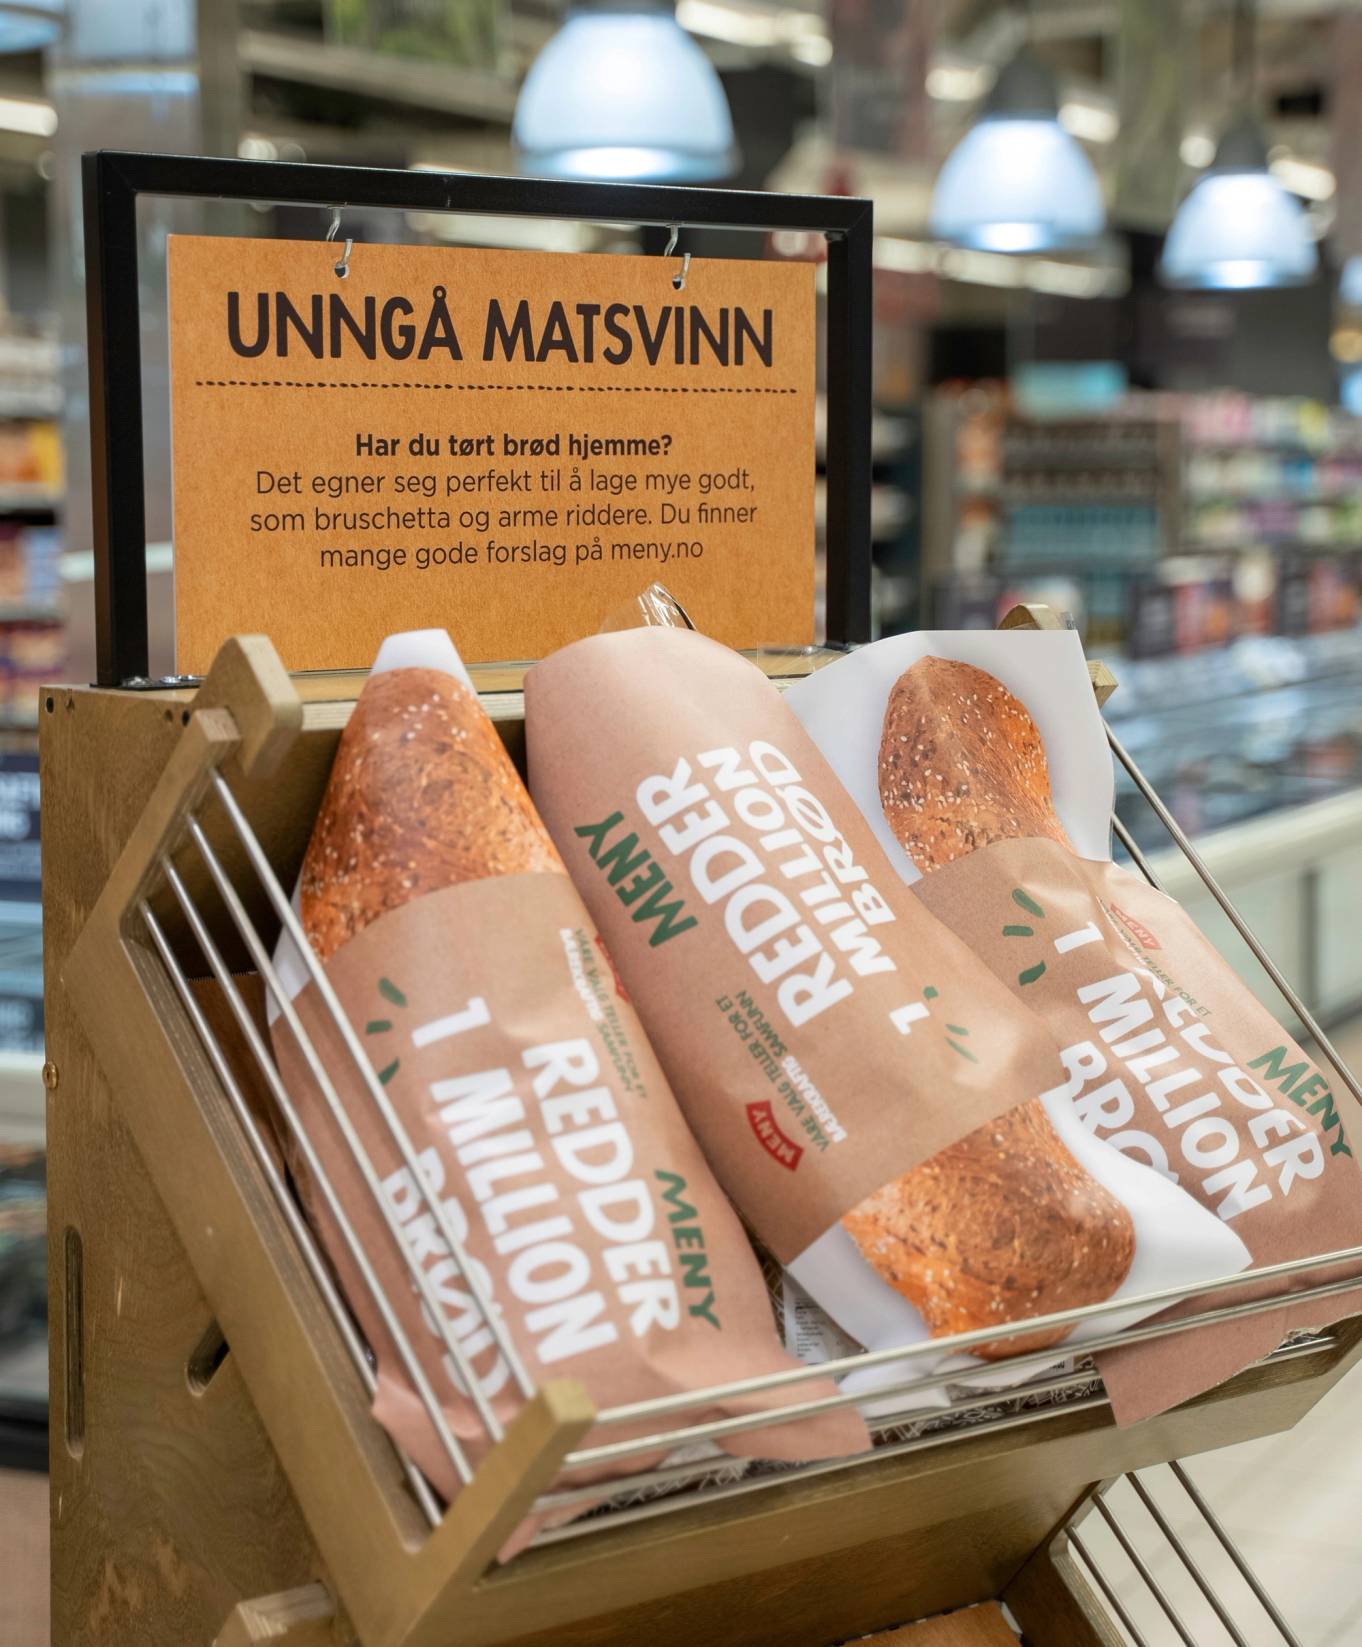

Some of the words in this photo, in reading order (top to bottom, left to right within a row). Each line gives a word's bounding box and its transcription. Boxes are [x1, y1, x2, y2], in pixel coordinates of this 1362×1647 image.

[227, 285, 463, 362] UNNGÅ
[482, 297, 774, 368] MATSVINN
[256, 470, 303, 494] Det
[311, 475, 386, 498] egner
[394, 474, 437, 497] seg
[446, 468, 532, 497] perfekt
[539, 468, 561, 491] til
[568, 466, 582, 491] å
[590, 468, 638, 496] lage
[645, 472, 691, 494] mye
[698, 467, 755, 494] godt,
[355, 433, 401, 457] Har
[408, 432, 440, 457] du
[448, 433, 495, 457] tørt
[503, 433, 560, 457] brød
[568, 433, 673, 460] hjemme?
[250, 513, 305, 532] som
[315, 506, 451, 531] bruschetta
[459, 510, 490, 533] og
[498, 509, 559, 528] arme
[566, 503, 652, 527] riddere.
[661, 502, 690, 525] Du
[697, 502, 758, 524] finner
[320, 548, 407, 571] mange
[415, 540, 479, 570] gode
[486, 539, 567, 566] forslag
[575, 536, 603, 565] på
[611, 541, 704, 564] meny.no
[696, 746, 897, 977] MILLION
[748, 739, 897, 927] BRØD
[573, 810, 699, 949] MENY
[635, 756, 855, 1029] REDDER
[1053, 920, 1105, 955] 1
[411, 996, 492, 1048] 1
[727, 1010, 753, 1042] FOR
[735, 989, 788, 1058] SAMFUNN
[888, 1001, 931, 1036] 1
[1076, 971, 1274, 1223] MILLION
[1246, 1044, 1353, 1159] MENY
[750, 1108, 797, 1164] MENY
[429, 1067, 620, 1366] MILLION
[521, 1038, 681, 1339] REDDER
[653, 1169, 721, 1332] MENY
